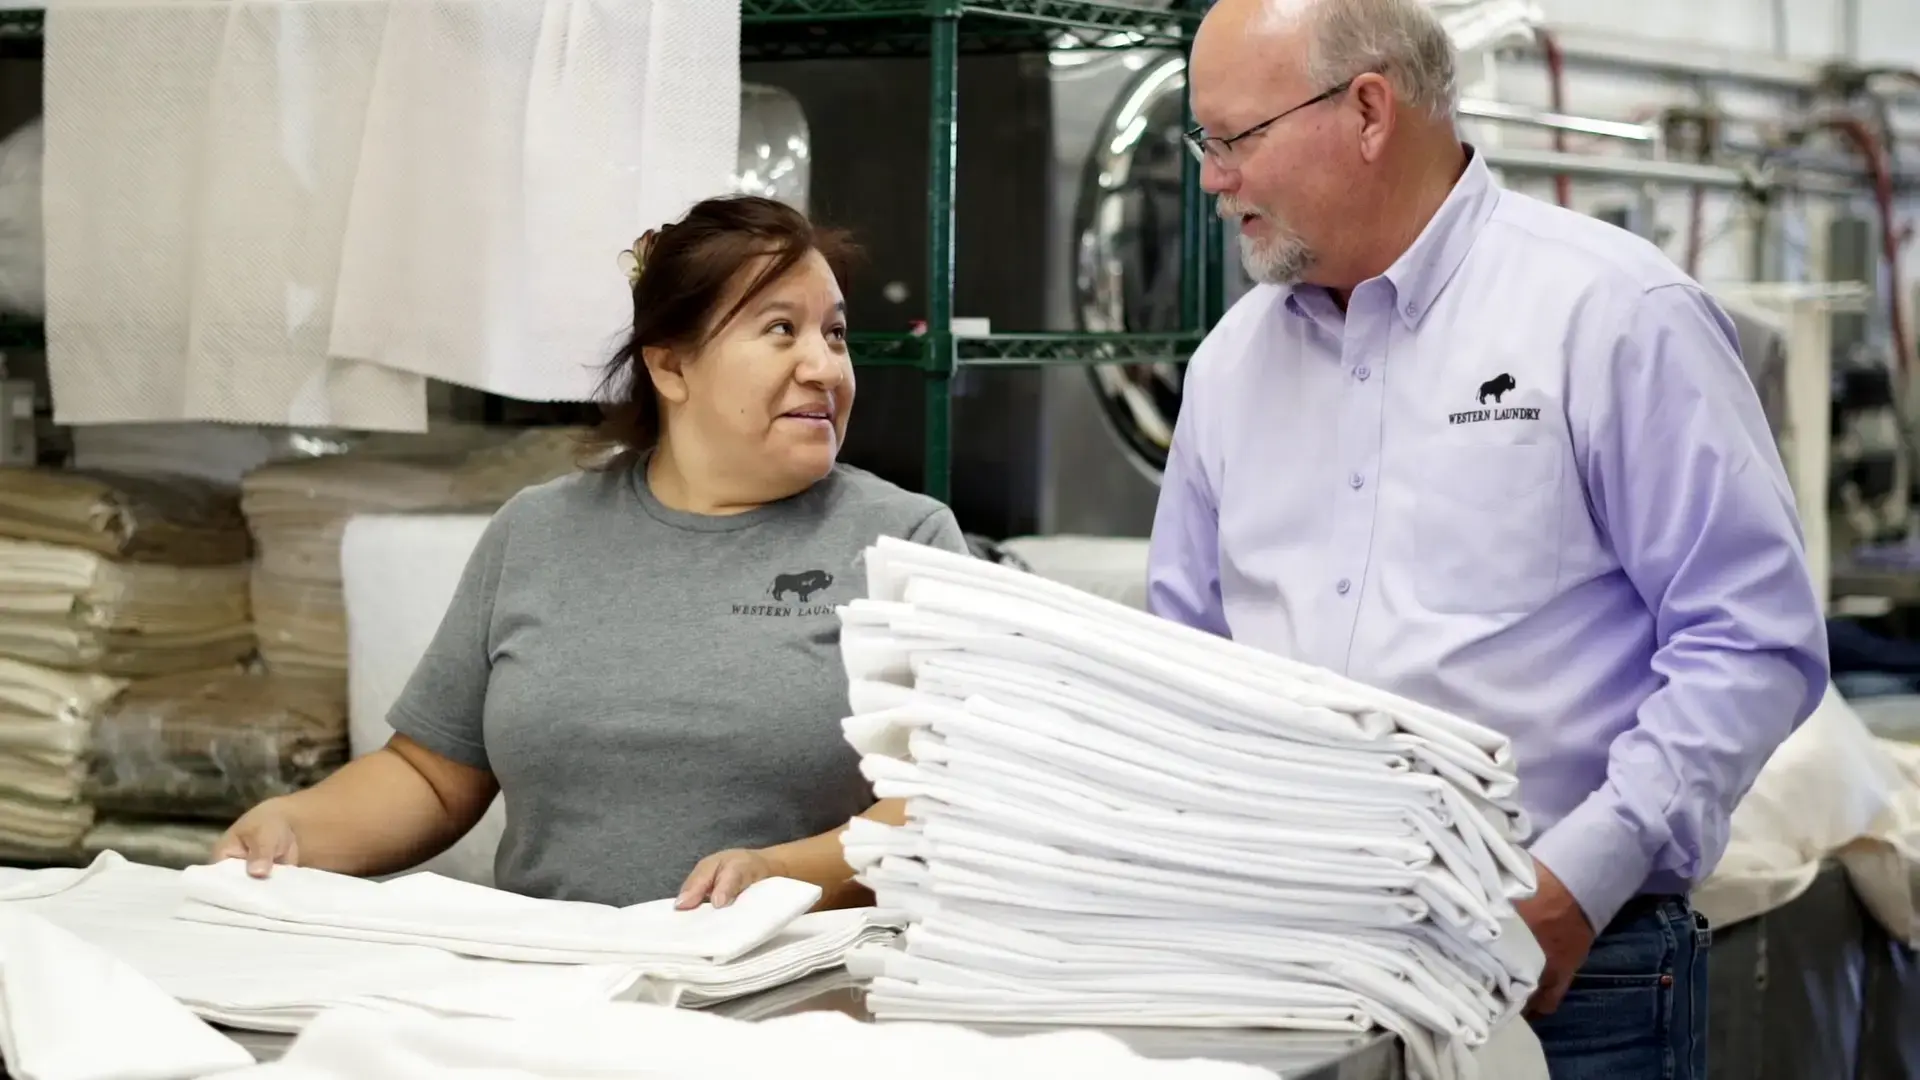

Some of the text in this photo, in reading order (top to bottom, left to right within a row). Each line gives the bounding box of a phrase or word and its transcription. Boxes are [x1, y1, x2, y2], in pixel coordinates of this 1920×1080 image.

[1448, 407, 1541, 424] WESTERN LAUNDRY
[732, 604, 792, 617] WESTERN
